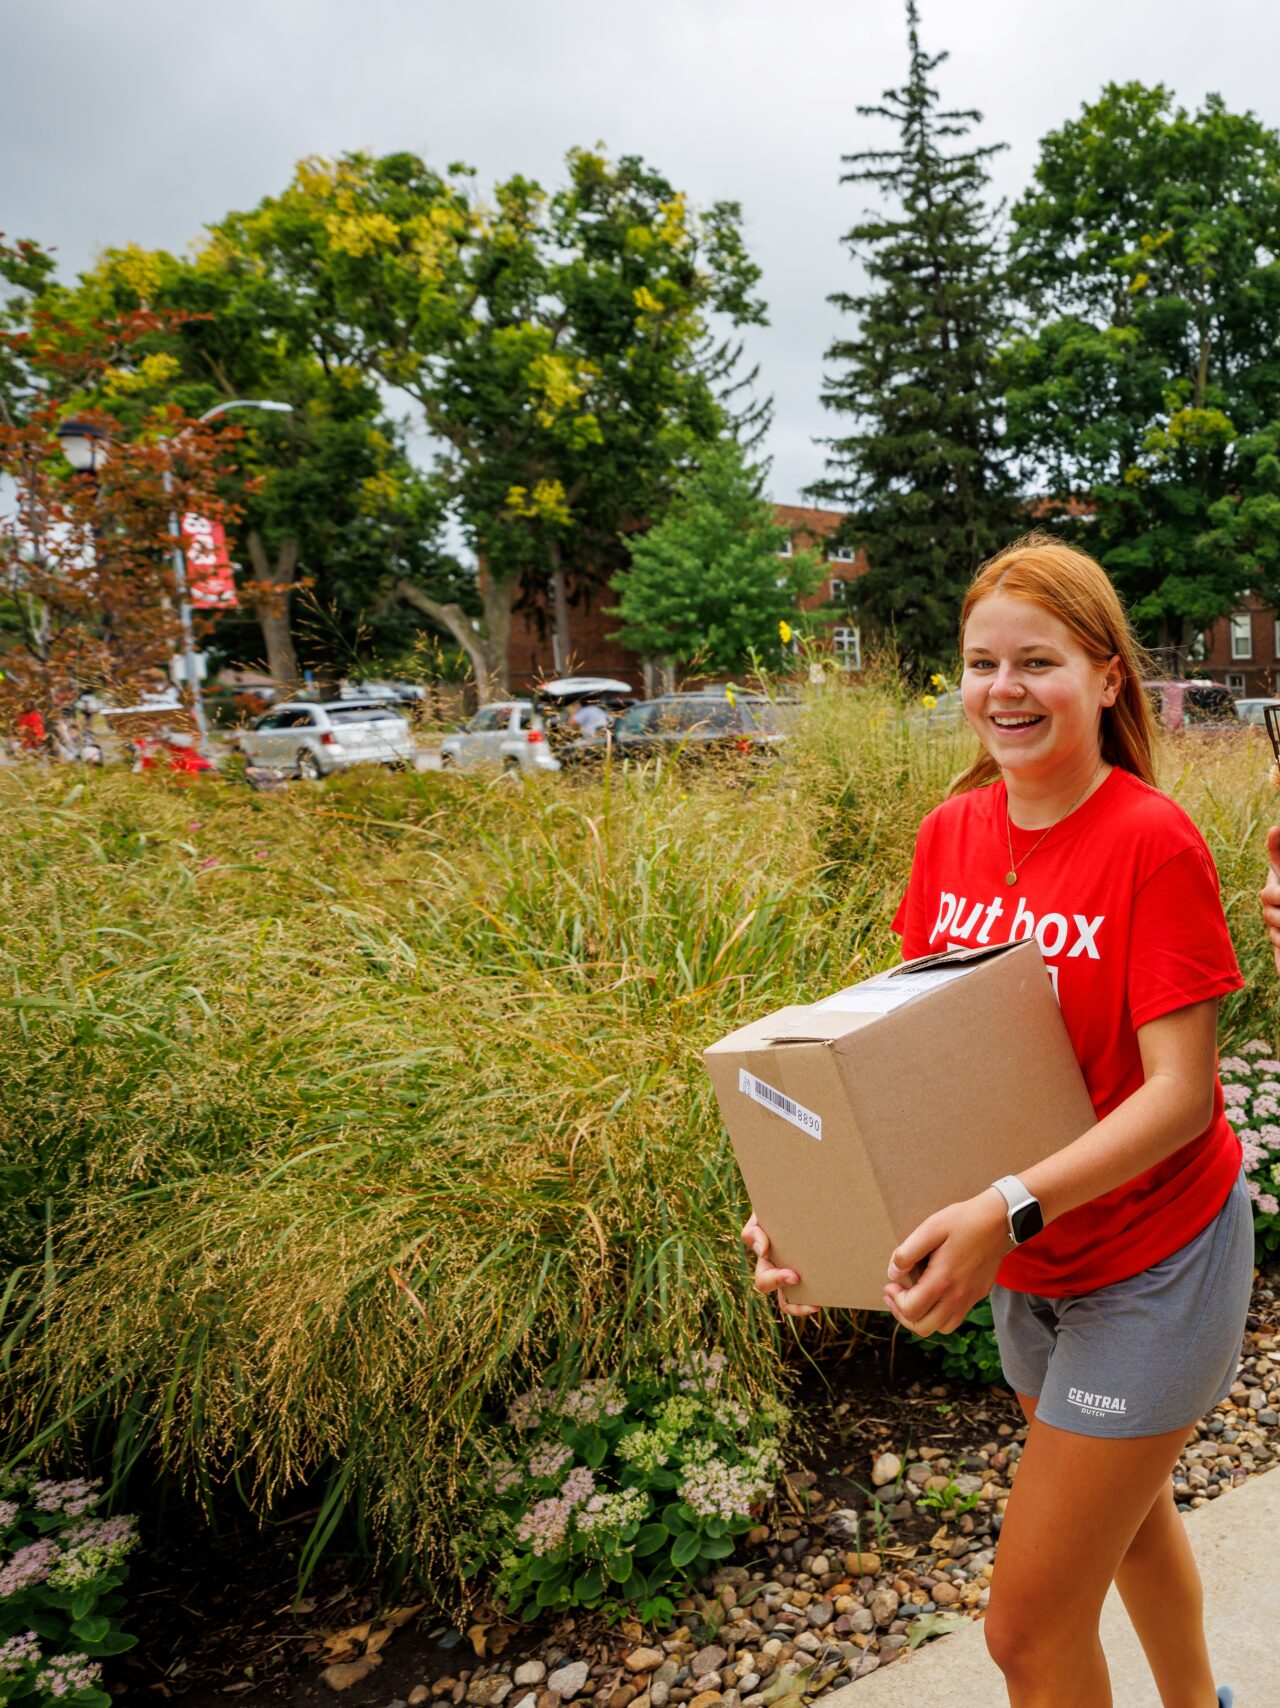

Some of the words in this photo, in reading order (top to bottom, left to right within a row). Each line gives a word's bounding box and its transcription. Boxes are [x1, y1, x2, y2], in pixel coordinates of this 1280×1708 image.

[929, 891, 1003, 944] put
[1008, 897, 1105, 959] box
[797, 1109, 820, 1132] 8890
[1067, 1387, 1127, 1411] CENTRAL
[1081, 1407, 1105, 1418] DUTCH
